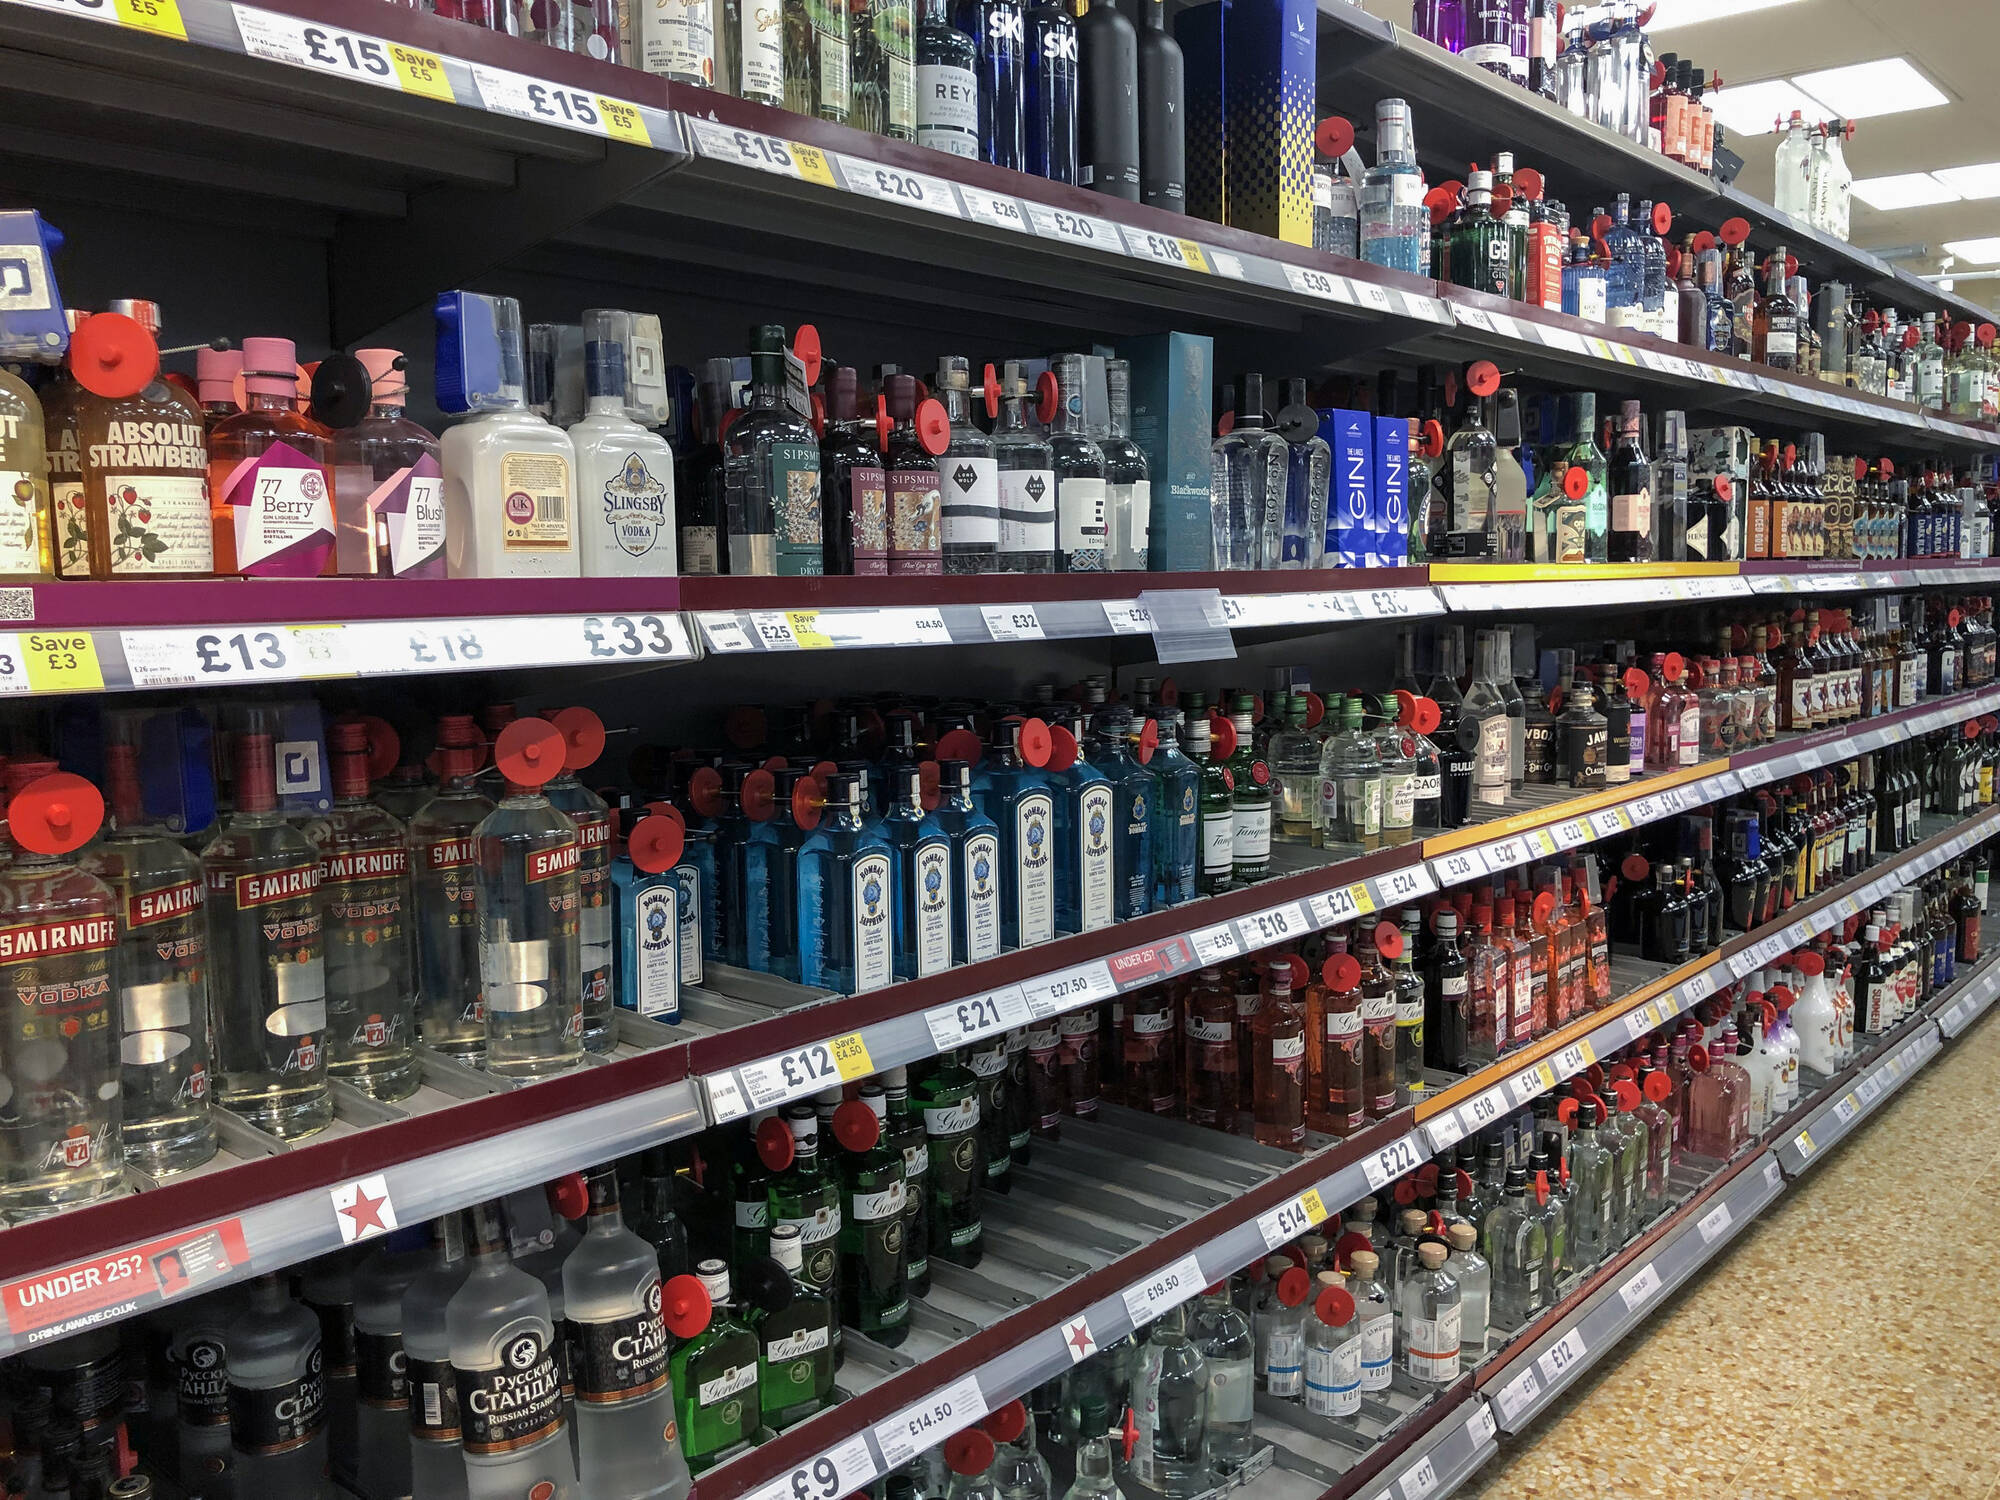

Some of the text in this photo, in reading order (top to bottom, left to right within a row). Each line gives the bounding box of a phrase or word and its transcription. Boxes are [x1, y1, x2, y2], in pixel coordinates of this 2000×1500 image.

[303, 27, 390, 76] £15
[394, 48, 438, 70] Save
[410, 66, 433, 82] £5
[527, 84, 597, 125] £15
[600, 99, 635, 118] Save
[613, 114, 632, 129] £5
[734, 132, 791, 167] £15
[792, 143, 820, 159] Save
[803, 156, 818, 169] £5
[875, 170, 923, 200] £20
[992, 200, 1019, 219] £26
[1055, 213, 1093, 239] £20
[1147, 235, 1183, 262] £18
[1489, 240, 1509, 260] GB
[1302, 271, 1331, 294] £39
[1492, 270, 1507, 279] GIN
[107, 421, 202, 447] ABSOLUT
[261, 479, 282, 494] 77
[892, 475, 939, 484] SIPSMITH
[1348, 457, 1366, 519] GIN
[415, 487, 430, 502] 77
[1170, 485, 1210, 496] Blackwoods
[1387, 463, 1402, 523] GIN
[263, 496, 314, 518] Berry
[416, 504, 444, 520] Blush
[512, 499, 528, 509] UK
[604, 491, 669, 515] SLINGSBY
[622, 525, 651, 537] VODKA
[1754, 506, 1765, 553] SPICED GOLD
[800, 567, 816, 576] DRY
[793, 614, 815, 623] Save
[915, 620, 943, 629] £24.50
[1012, 614, 1037, 628] £32
[1129, 609, 1149, 621] £28
[583, 615, 672, 657] £33
[761, 626, 790, 639] £25
[30, 635, 86, 651] Save
[196, 632, 286, 673] £13
[48, 654, 77, 670] £3
[1087, 797, 1108, 813] BOMBAY
[1660, 792, 1681, 811] £14
[1023, 806, 1047, 824] BOMBAY
[1603, 812, 1620, 829] £25
[1565, 823, 1583, 841] £22
[970, 843, 992, 859] BOMBAY
[1085, 840, 1109, 858] SAPPHIRE
[1495, 842, 1517, 863] £22
[320, 852, 405, 877] SMIRNOFF
[922, 853, 944, 868] BOMBAY
[1023, 852, 1048, 870] SAPPHIRE
[1449, 855, 1471, 876] £28
[860, 864, 885, 882] BOMBAY
[971, 885, 995, 901] SAPPHIRE
[1393, 873, 1417, 894] £24
[332, 899, 401, 919] VODKA
[643, 894, 671, 911] BOMBAY
[922, 897, 947, 913] SAPPHIRE
[1327, 889, 1355, 915] £21
[860, 909, 886, 927] SAPPHIRE
[1259, 912, 1288, 938] £18
[642, 939, 672, 952] SAPPHIRE
[1213, 935, 1233, 949] £35
[1115, 952, 1142, 970] UNDER
[16, 981, 110, 1006] VODKA
[1050, 977, 1087, 998] £27.50
[957, 996, 1000, 1033] £21
[1635, 1009, 1650, 1029] £14
[835, 1036, 856, 1050] Save
[836, 1044, 862, 1061] £4.50
[1565, 1044, 1583, 1069] £14
[780, 1046, 836, 1088] £12
[1522, 1070, 1542, 1093] £14
[1473, 1097, 1495, 1121] £18
[1380, 1142, 1415, 1178] £22
[1278, 1203, 1307, 1234] £14
[18, 1268, 101, 1307] UNDER
[105, 1255, 143, 1283] 25?
[1147, 1274, 1180, 1302] £19.50
[1551, 1341, 1573, 1368] £12
[1522, 1377, 1536, 1395] £17
[489, 1408, 529, 1426] RUSSIAN
[508, 1410, 556, 1432] VODKA
[909, 1402, 952, 1436] £14.50
[1483, 1410, 1493, 1430] £17
[791, 1457, 840, 1500] £9
[1417, 1468, 1433, 1487] £17
